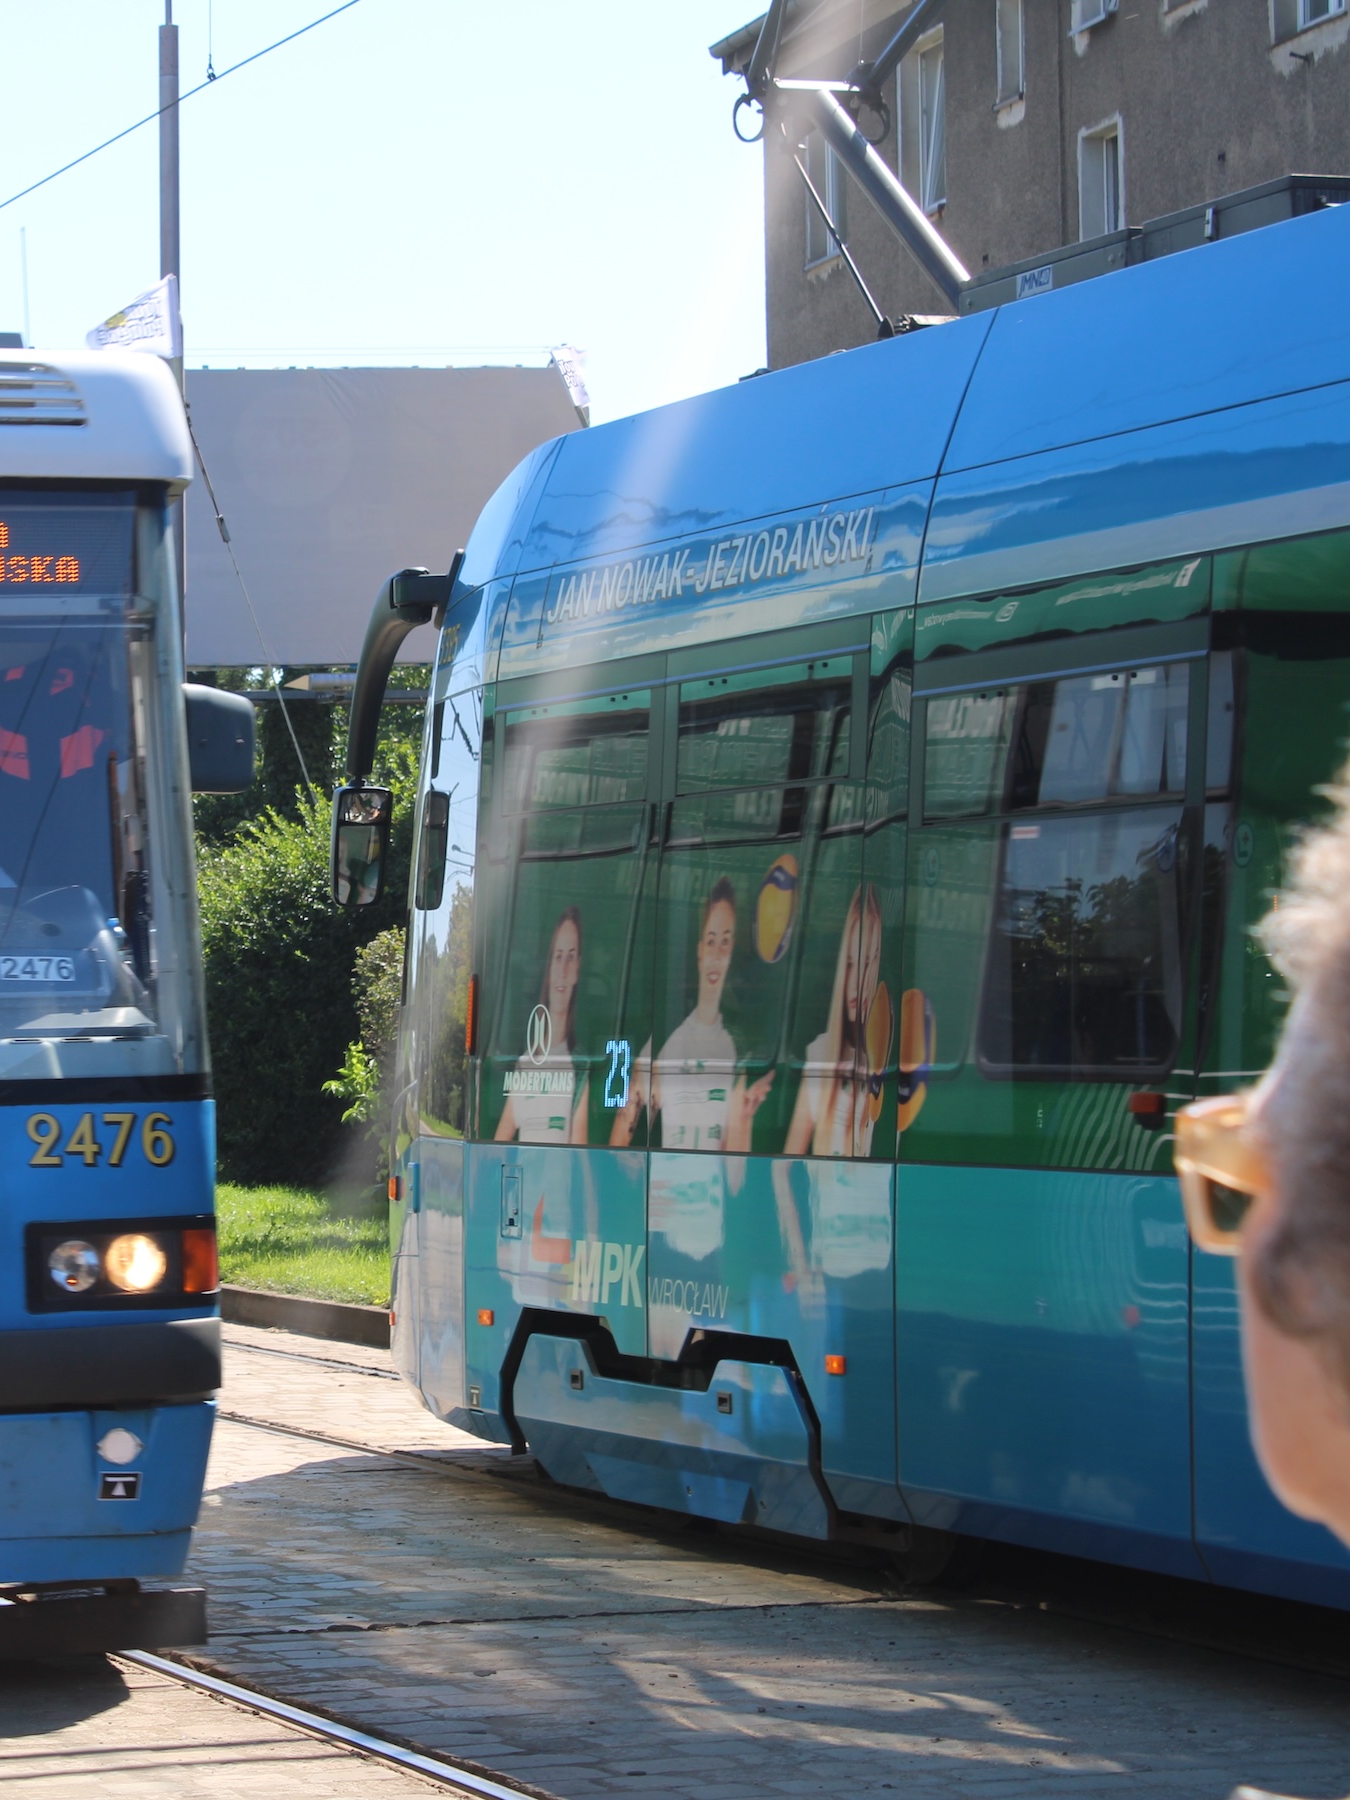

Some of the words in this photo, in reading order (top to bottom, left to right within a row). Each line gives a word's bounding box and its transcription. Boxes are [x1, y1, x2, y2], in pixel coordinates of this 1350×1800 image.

[547, 569, 598, 624] JAN
[596, 504, 876, 613] NOWAK-JEZIORAŃSKI
[1, 958, 74, 980] 2476
[503, 1071, 573, 1092] MODERTRANS
[604, 1040, 631, 1107] 23
[26, 1111, 175, 1167] 2476
[572, 1240, 646, 1308] MPK
[648, 1276, 729, 1319] WROCŁAW
